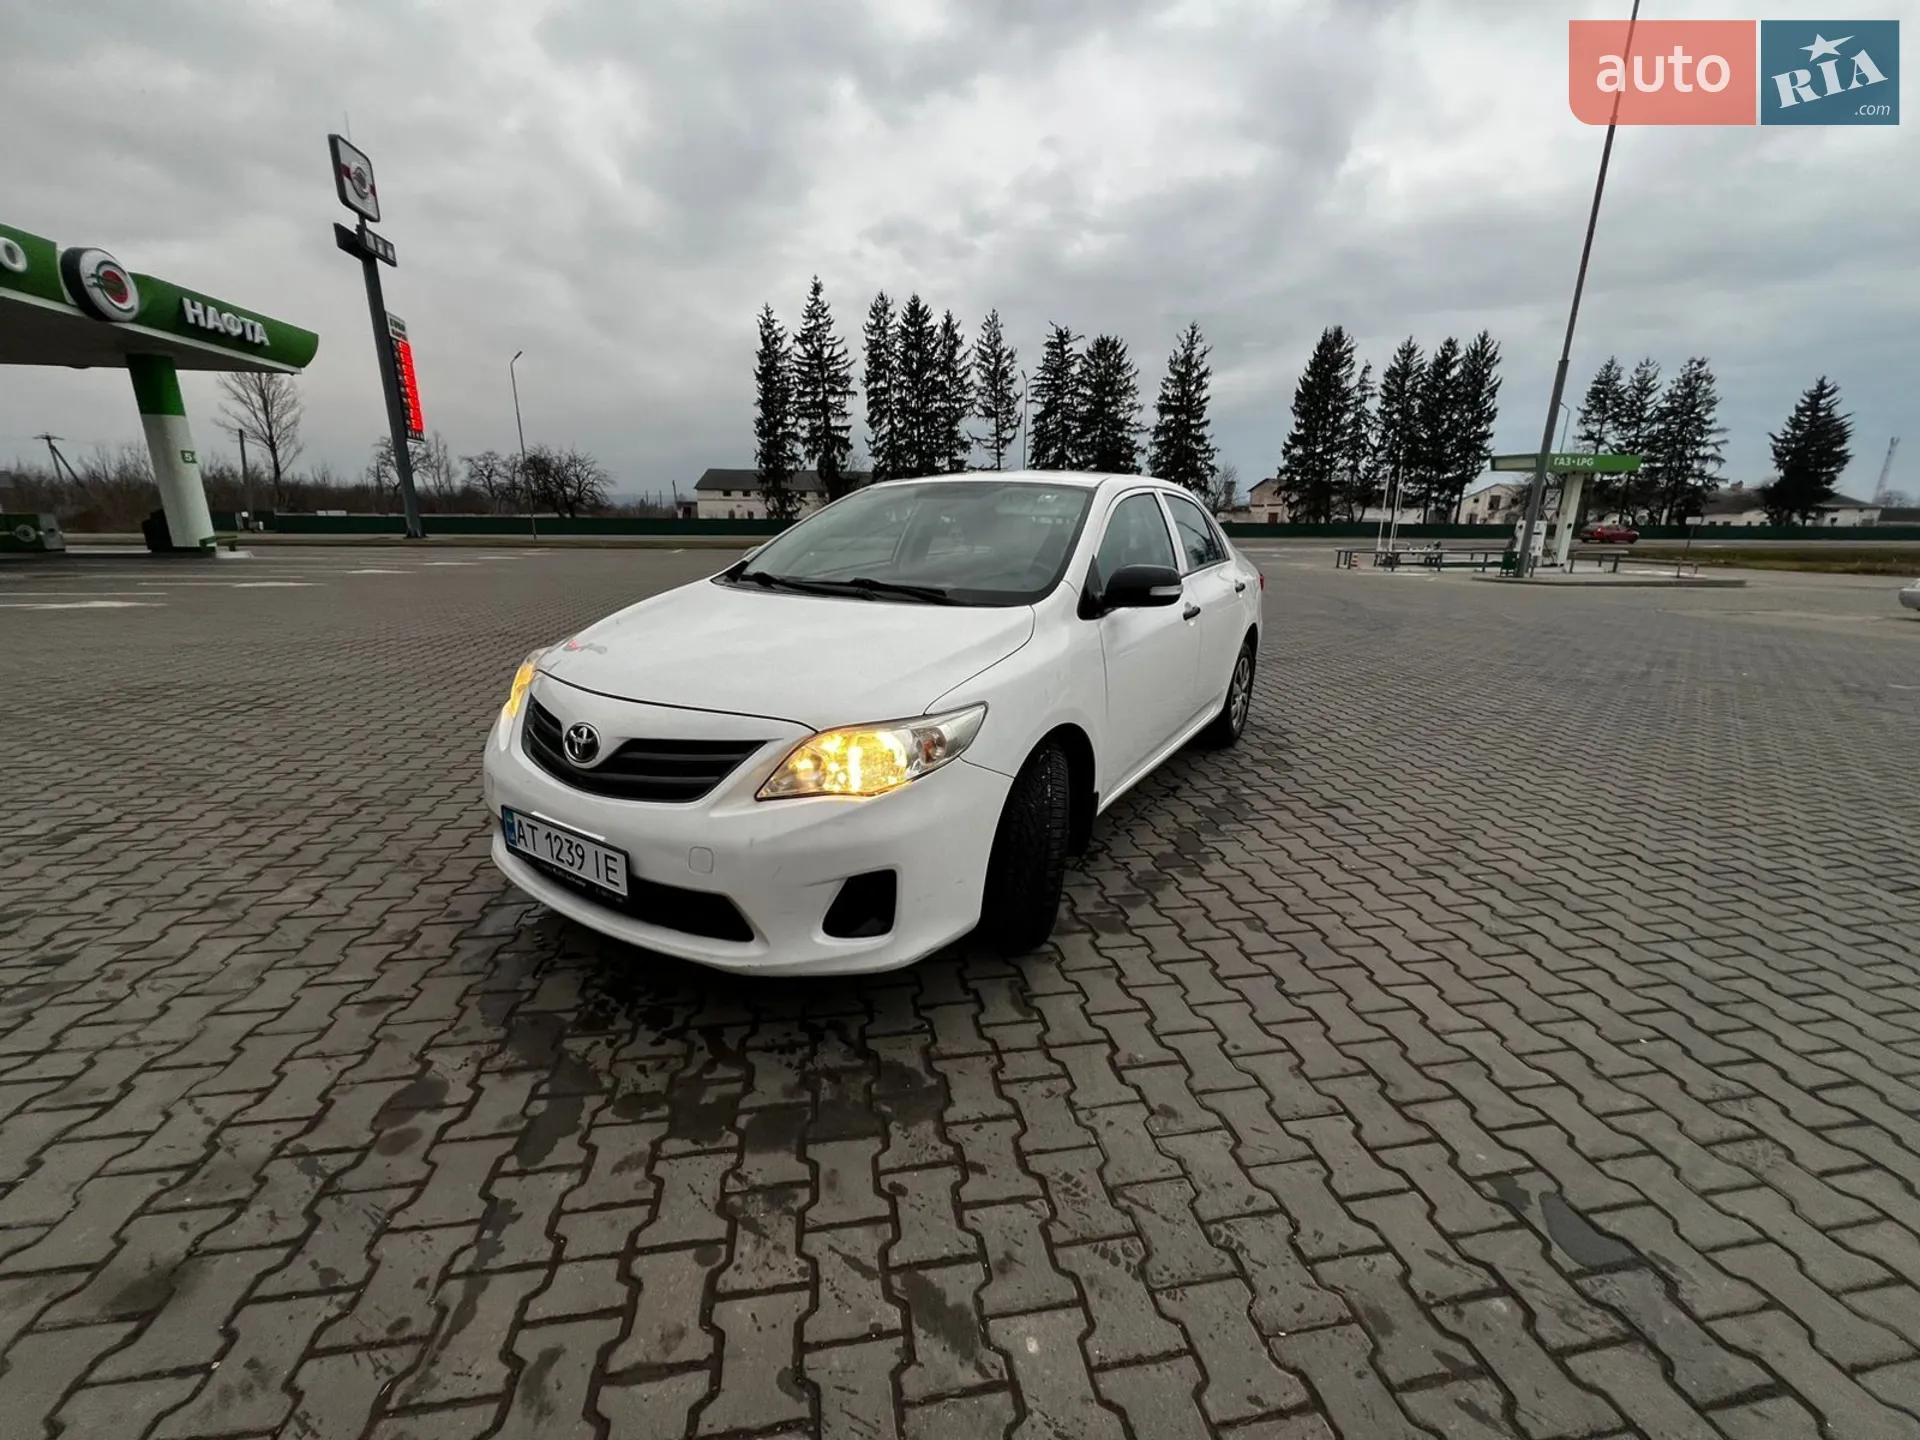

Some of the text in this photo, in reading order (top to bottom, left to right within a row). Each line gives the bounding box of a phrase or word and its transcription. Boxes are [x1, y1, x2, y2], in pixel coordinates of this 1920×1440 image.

[182, 297, 270, 346] НАФТА
[1576, 457, 1594, 467] LPG
[517, 820, 538, 852] AT
[545, 832, 585, 871] 1239
[594, 850, 620, 888] IE
